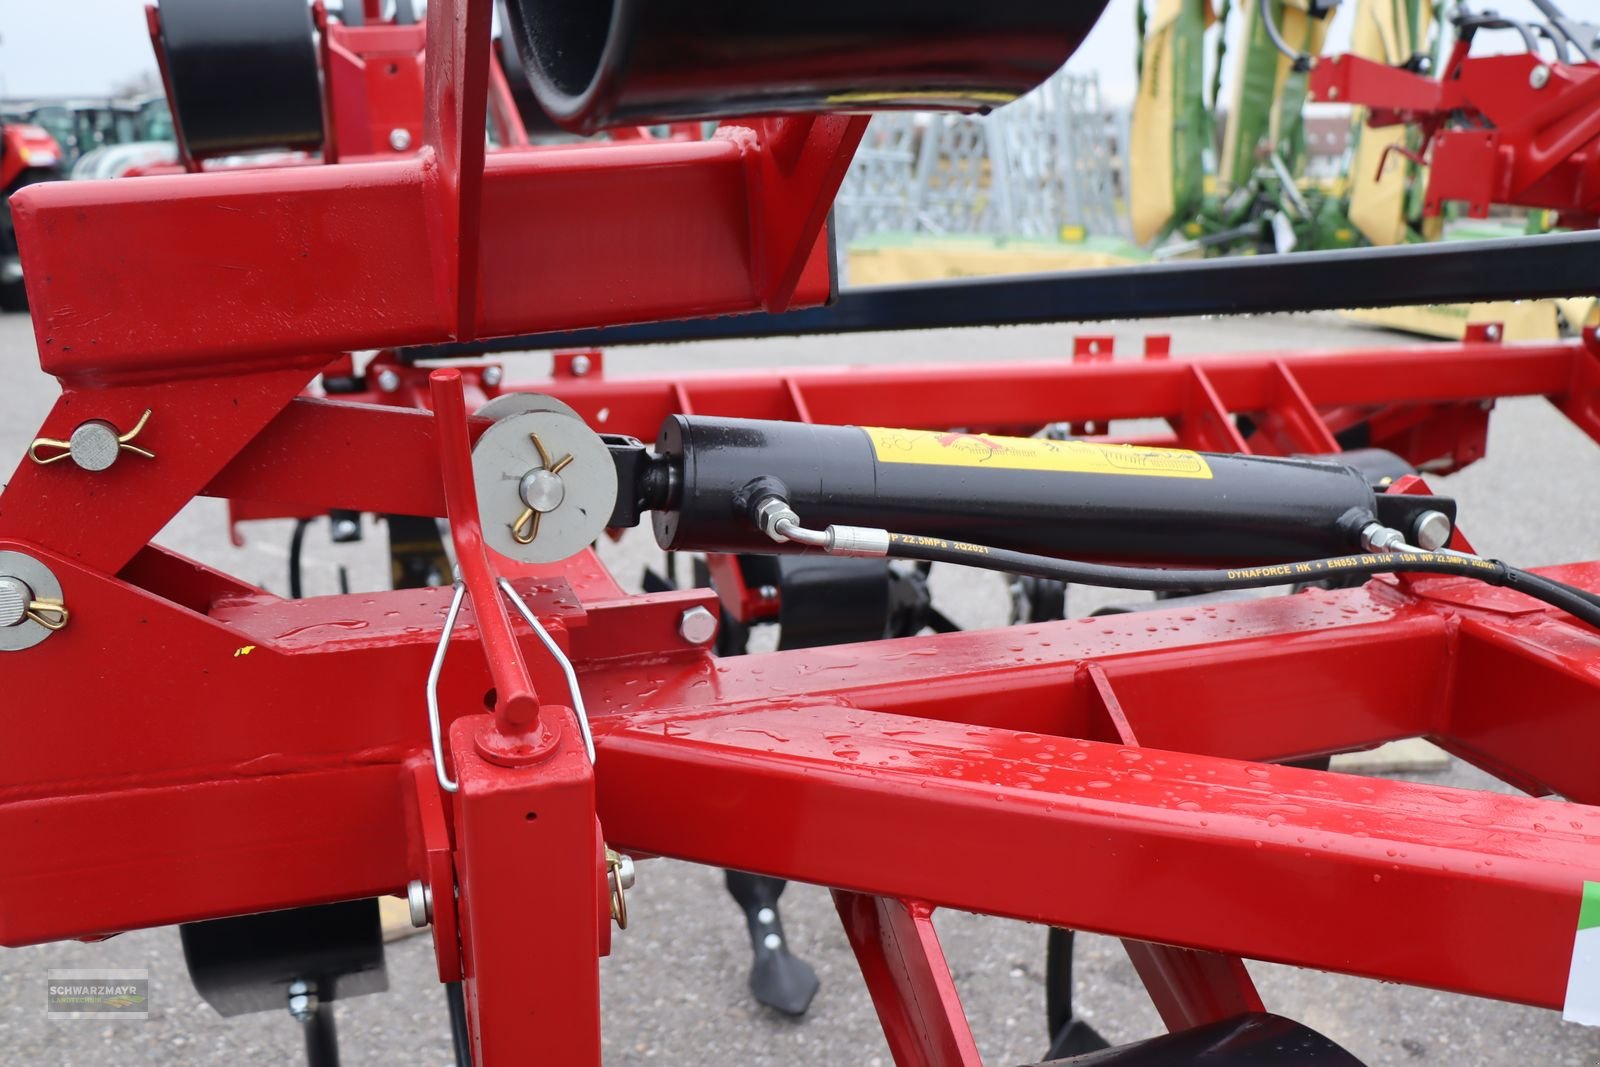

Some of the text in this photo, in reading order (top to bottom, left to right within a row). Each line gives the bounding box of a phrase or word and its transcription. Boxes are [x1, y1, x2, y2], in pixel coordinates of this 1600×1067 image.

[902, 534, 947, 548] 22.5MPa
[954, 542, 989, 554] 2Q2021
[1227, 566, 1292, 579] DYNAFORCE
[1296, 563, 1312, 573] HK
[1327, 557, 1358, 568] EN853
[1361, 555, 1376, 565] DN
[1420, 554, 1434, 562] WP
